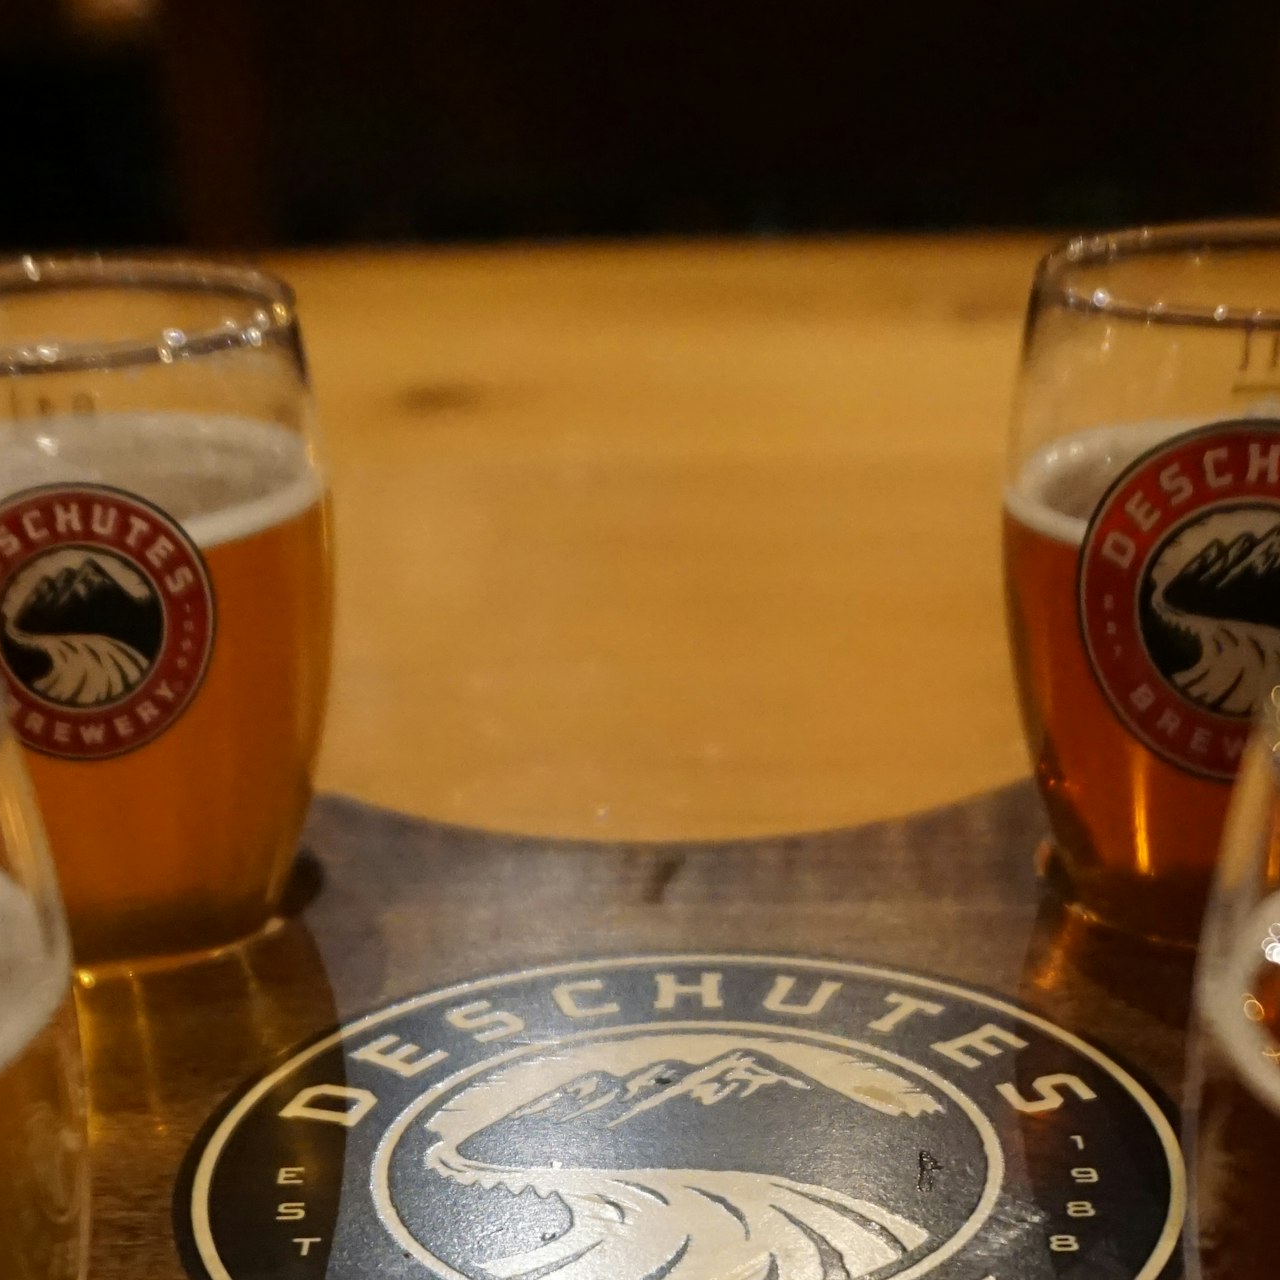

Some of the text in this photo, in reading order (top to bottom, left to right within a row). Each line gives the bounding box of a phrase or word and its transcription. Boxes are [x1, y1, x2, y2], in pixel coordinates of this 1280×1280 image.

[278, 971, 1097, 1129] DESCHUTES
[275, 1166, 322, 1256] EST
[1049, 1134, 1099, 1251] 1988
